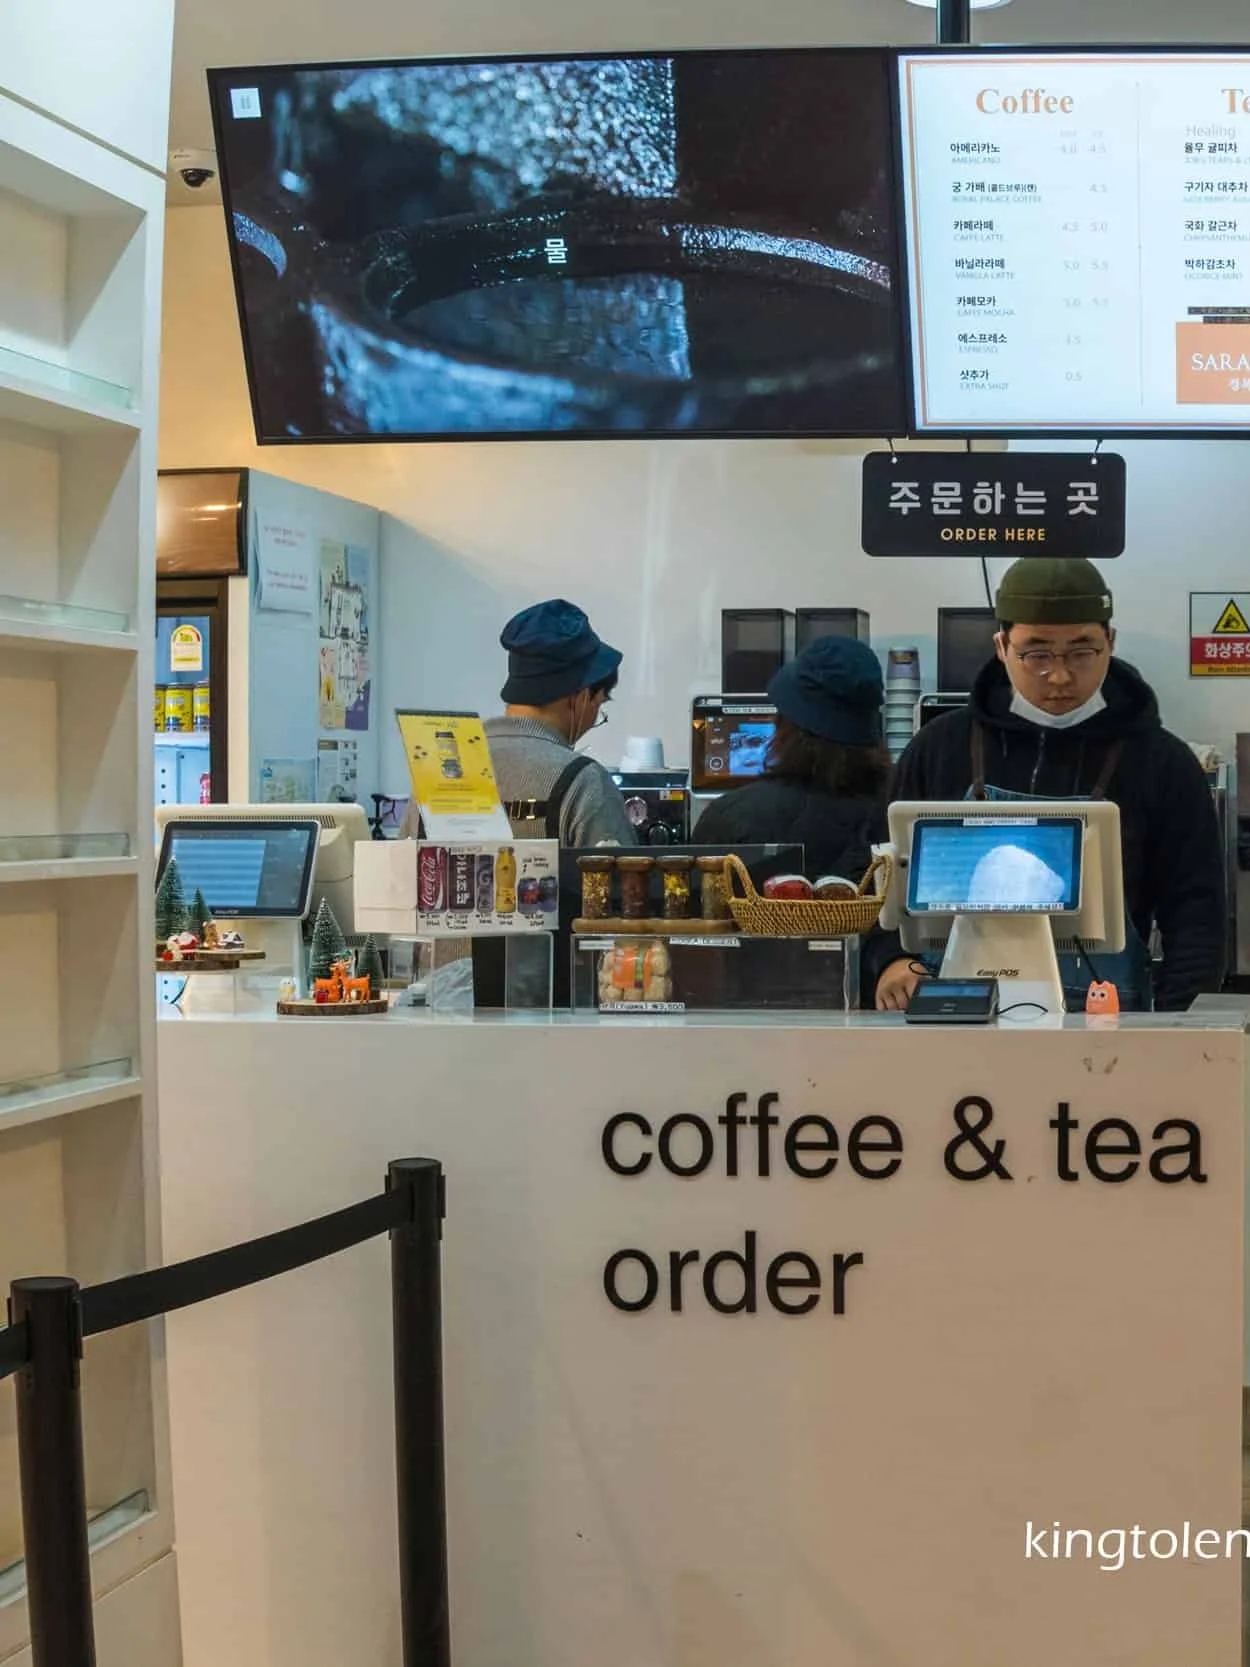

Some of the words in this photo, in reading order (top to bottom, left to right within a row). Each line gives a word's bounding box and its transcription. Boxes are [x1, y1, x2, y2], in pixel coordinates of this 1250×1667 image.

[976, 88, 1074, 114] Coffee
[1185, 124, 1236, 140] Healing
[950, 142, 1000, 154] 아메리카노
[1184, 181, 1214, 193] 구기자
[1217, 181, 1248, 193] 대추차
[953, 219, 994, 232] 카페라떼
[1184, 220, 1204, 232] 국화
[544, 238, 568, 264] 물
[1184, 258, 1236, 271] 박하감초차
[956, 295, 997, 307] 카페모카
[957, 332, 1008, 345] 에스프레소
[888, 480, 1047, 516] 주문하는
[1065, 480, 1100, 516] 곳
[940, 528, 997, 542] ORDER
[1004, 528, 1047, 542] HERE
[601, 1092, 904, 1179] coffee
[943, 1095, 1014, 1182] &
[1048, 1101, 1208, 1184] tea
[602, 1230, 864, 1315] order
